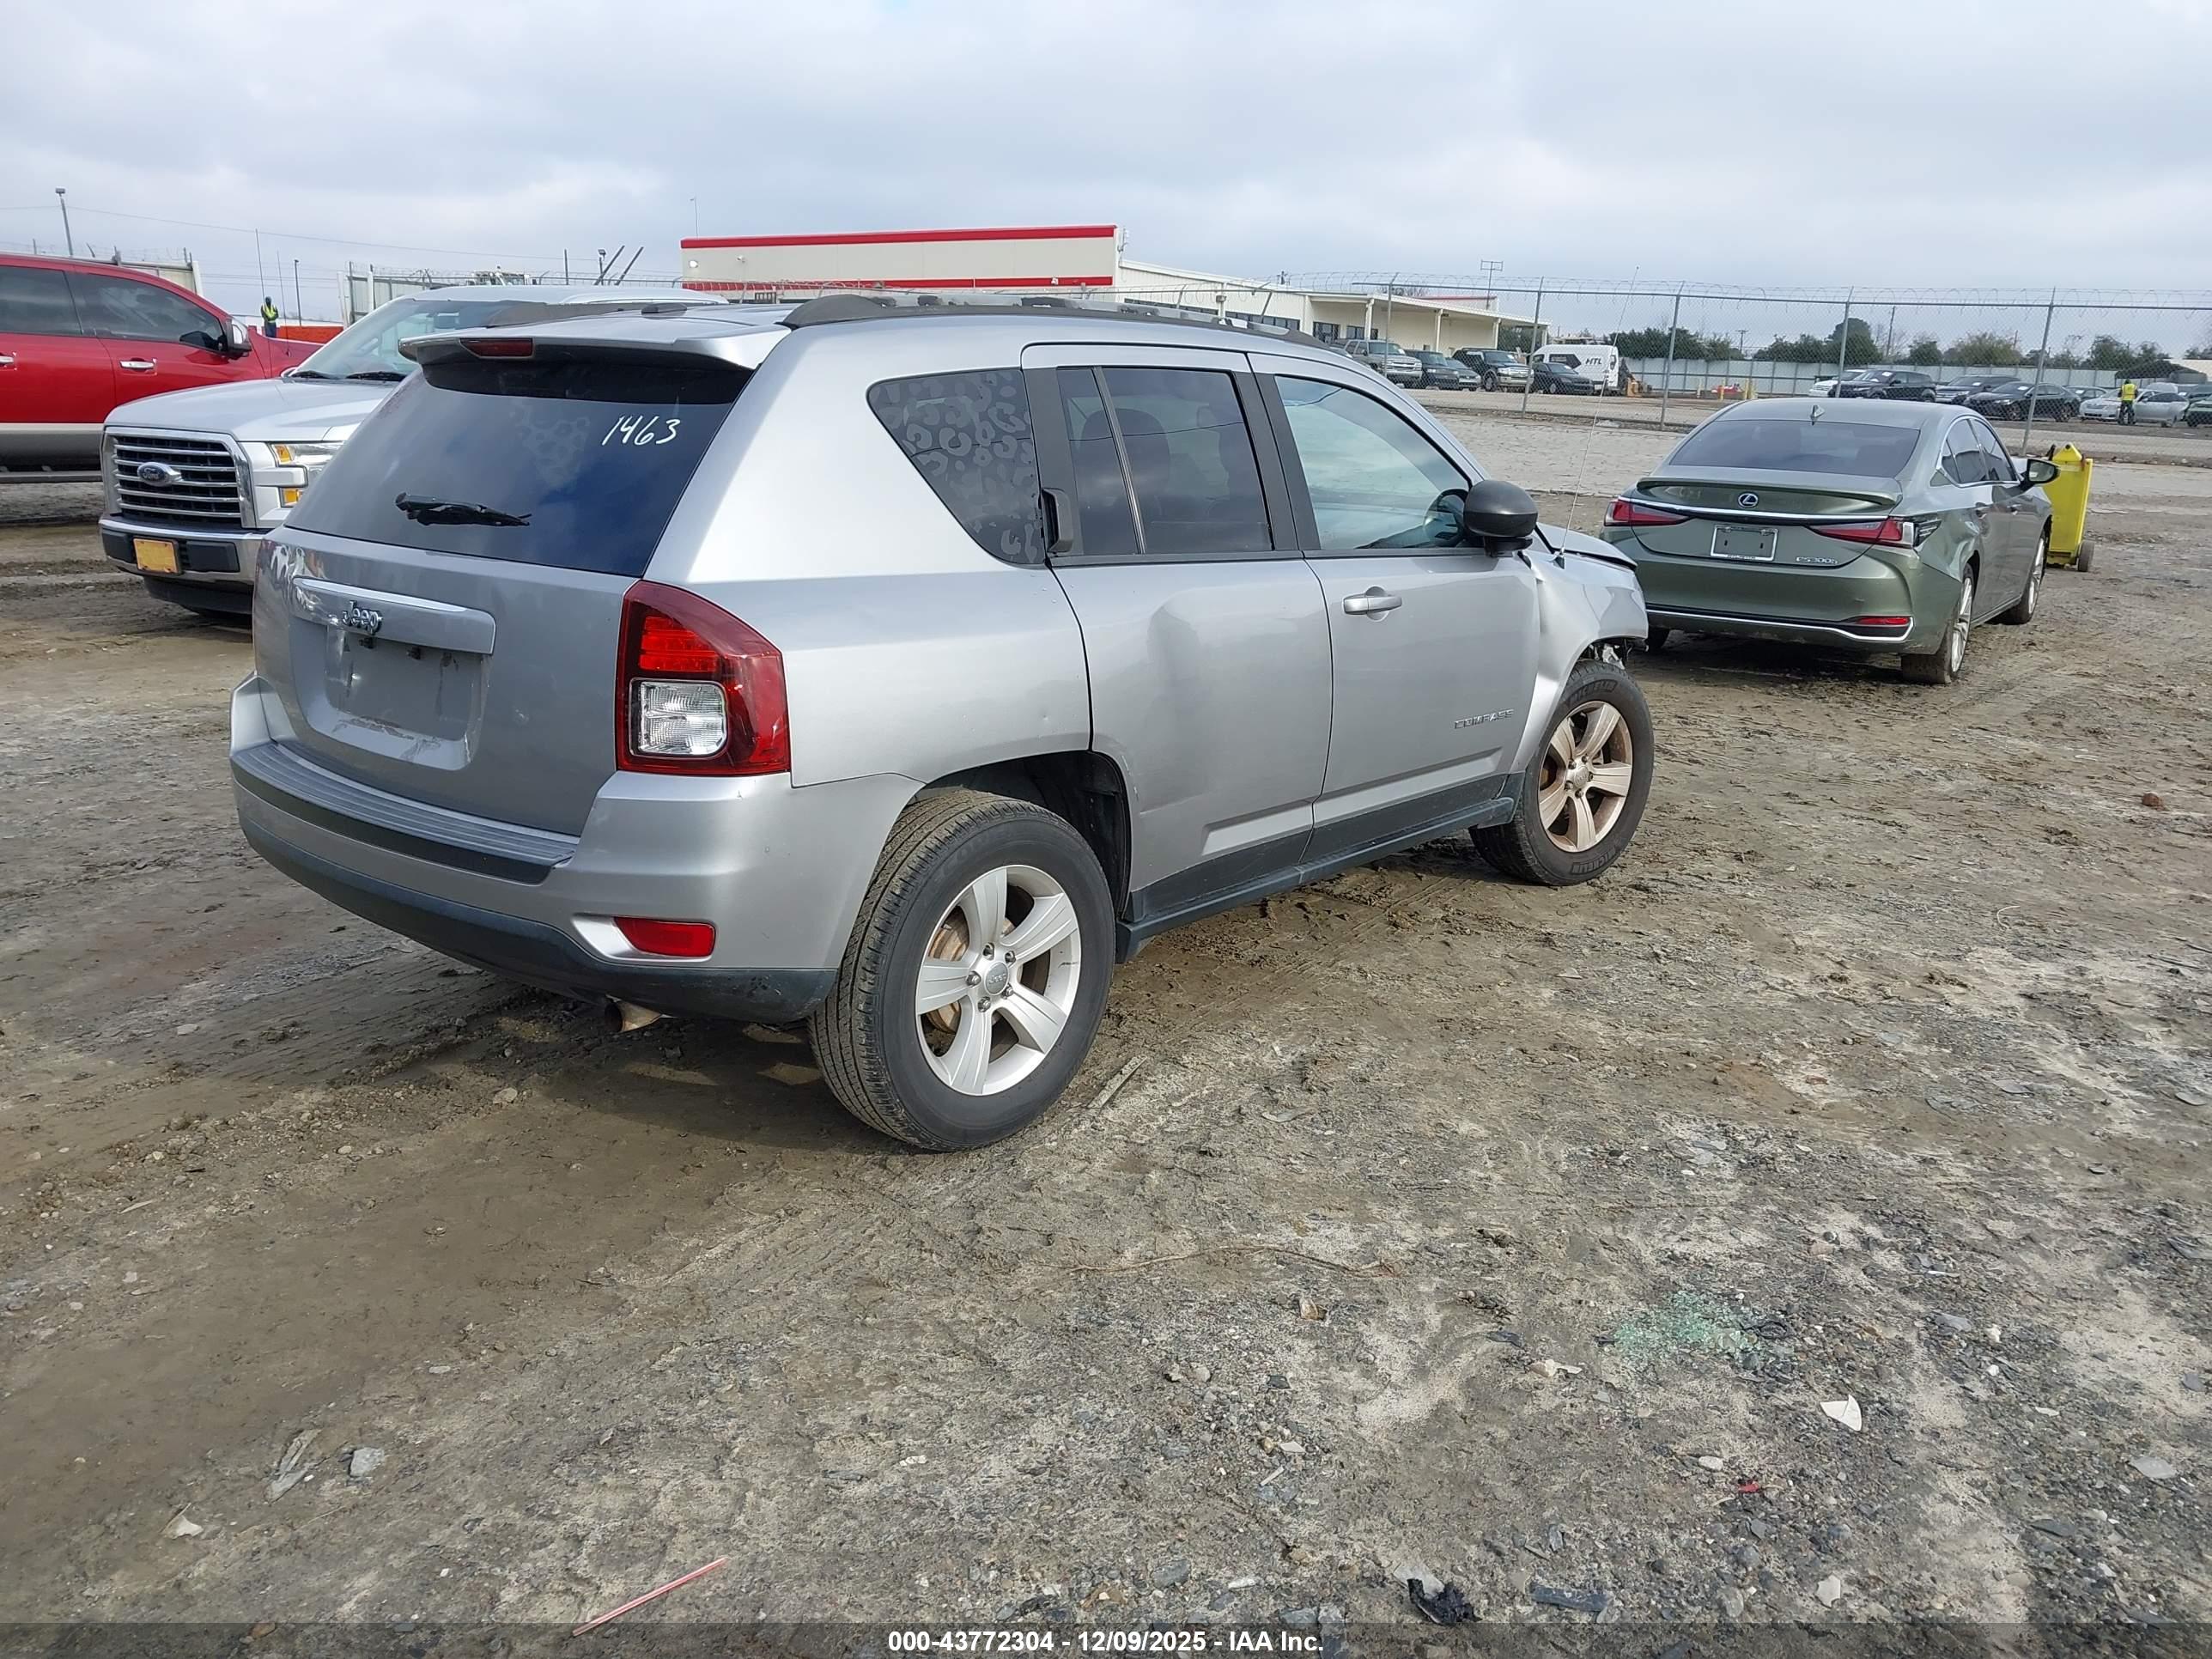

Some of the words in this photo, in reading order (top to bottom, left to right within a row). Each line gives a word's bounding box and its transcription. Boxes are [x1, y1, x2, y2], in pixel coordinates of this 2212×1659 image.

[601, 416, 681, 446] 1463
[342, 600, 381, 635] Jeep
[1454, 708, 1515, 729] COMPASS
